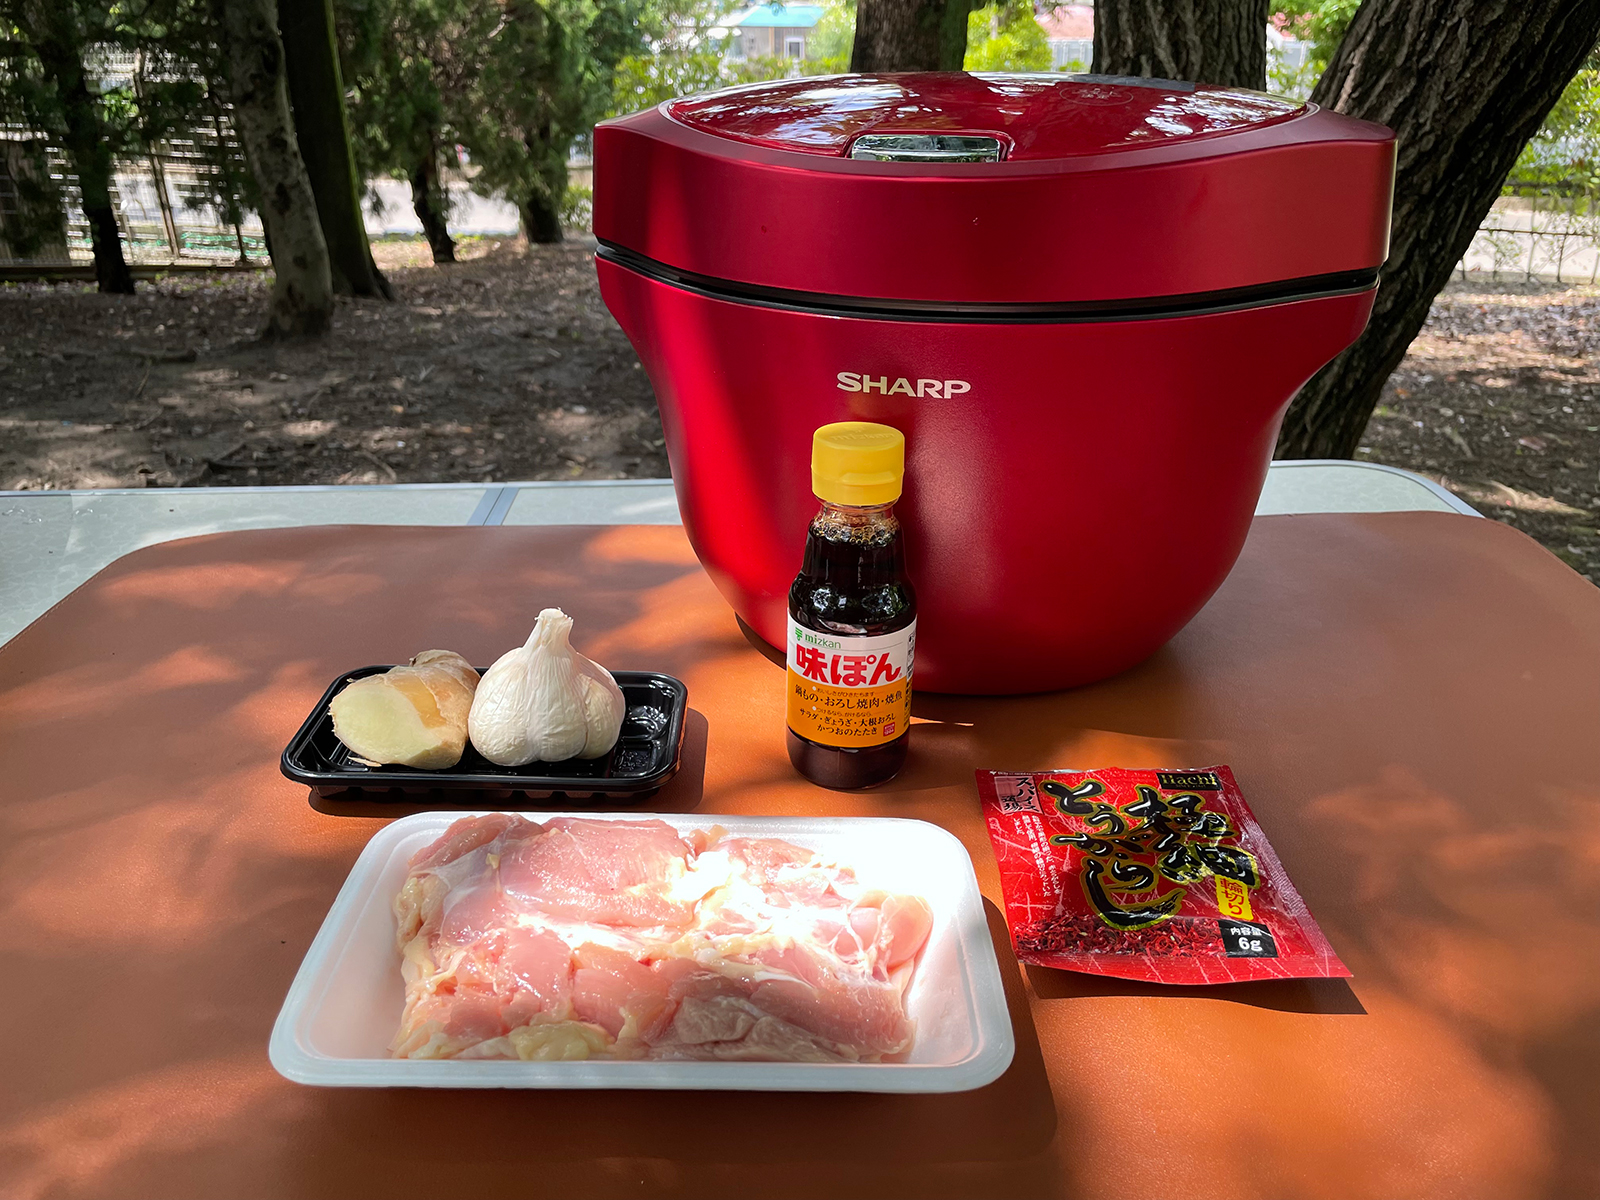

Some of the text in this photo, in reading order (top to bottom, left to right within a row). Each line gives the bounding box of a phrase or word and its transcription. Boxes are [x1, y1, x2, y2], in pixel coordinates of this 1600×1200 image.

[837, 371, 971, 399] SHARP
[805, 634, 841, 649] mizkan
[796, 643, 902, 687] 味ぽん
[817, 724, 878, 737] かつおのたたき
[1161, 773, 1218, 786] Hachi
[1220, 878, 1245, 915] 輪切り
[1230, 926, 1262, 936] 内容量
[1238, 936, 1263, 952] 6g
